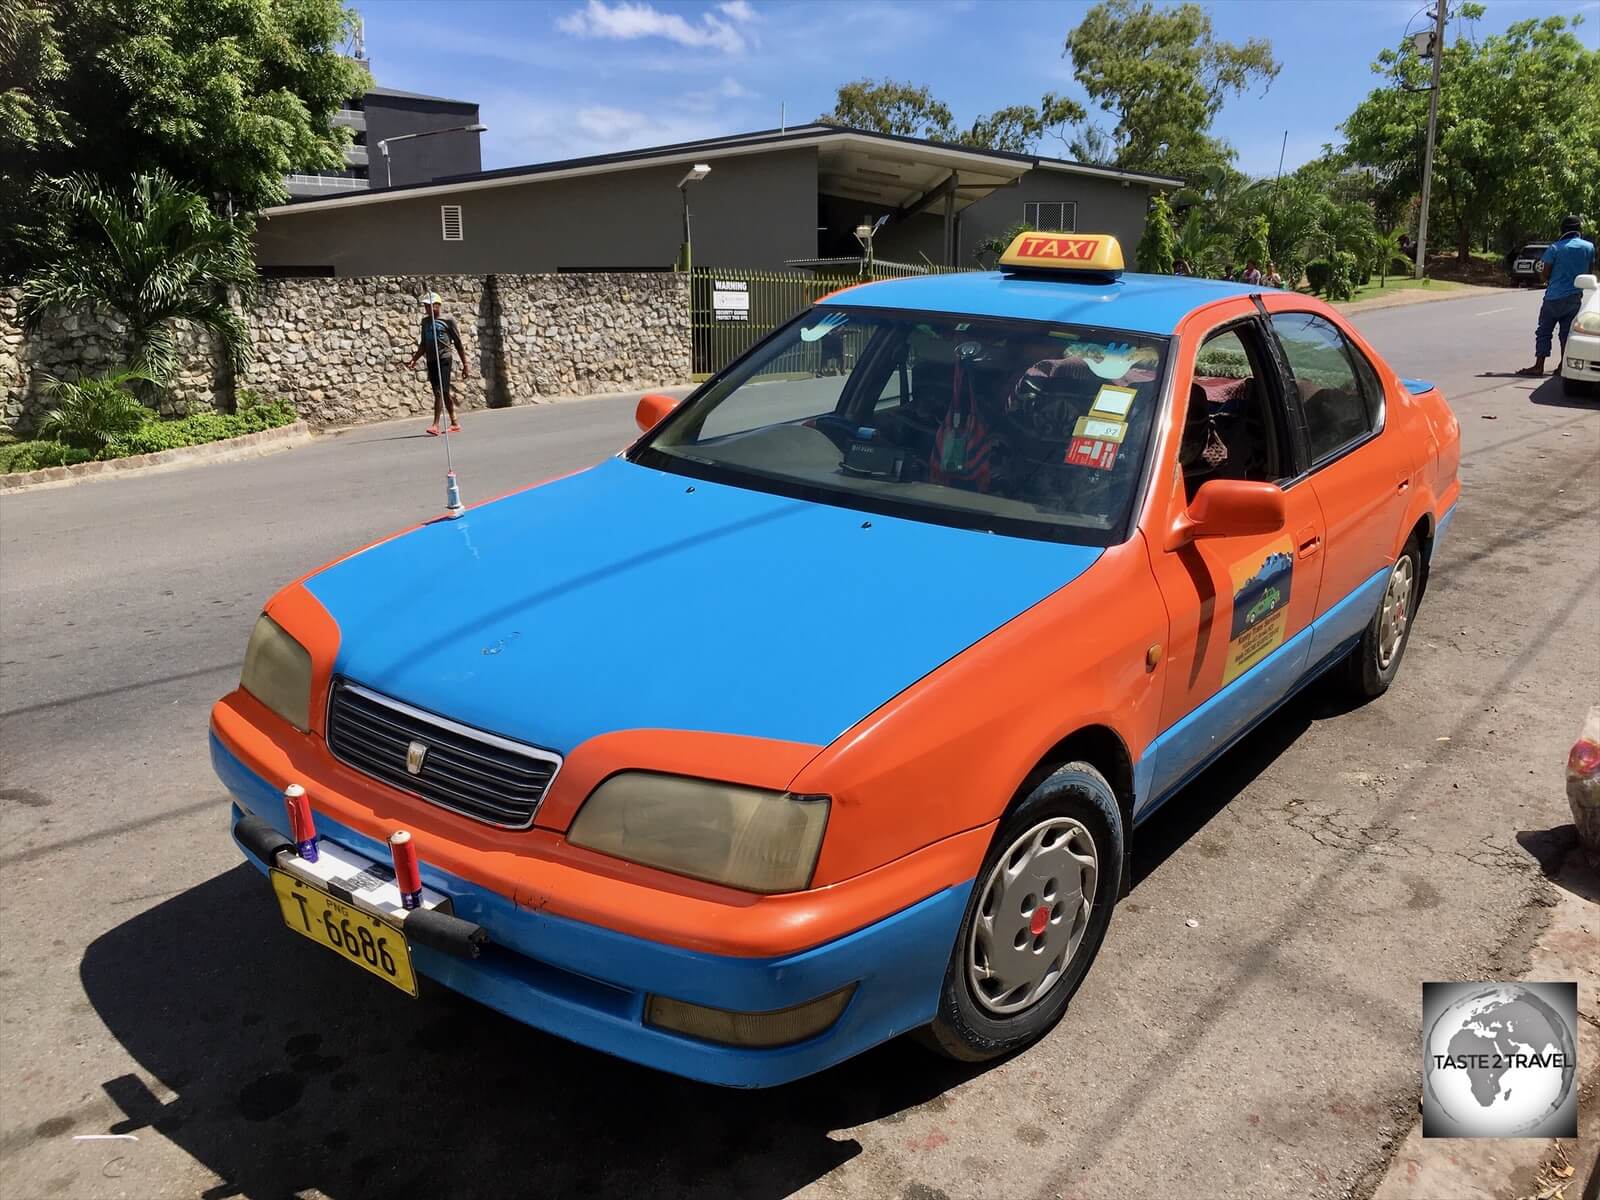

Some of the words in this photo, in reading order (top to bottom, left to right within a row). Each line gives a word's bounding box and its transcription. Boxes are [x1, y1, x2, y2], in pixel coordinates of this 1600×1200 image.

[1024, 239, 1096, 257] TAXI
[715, 280, 747, 291] WARNING
[325, 898, 350, 918] PNG
